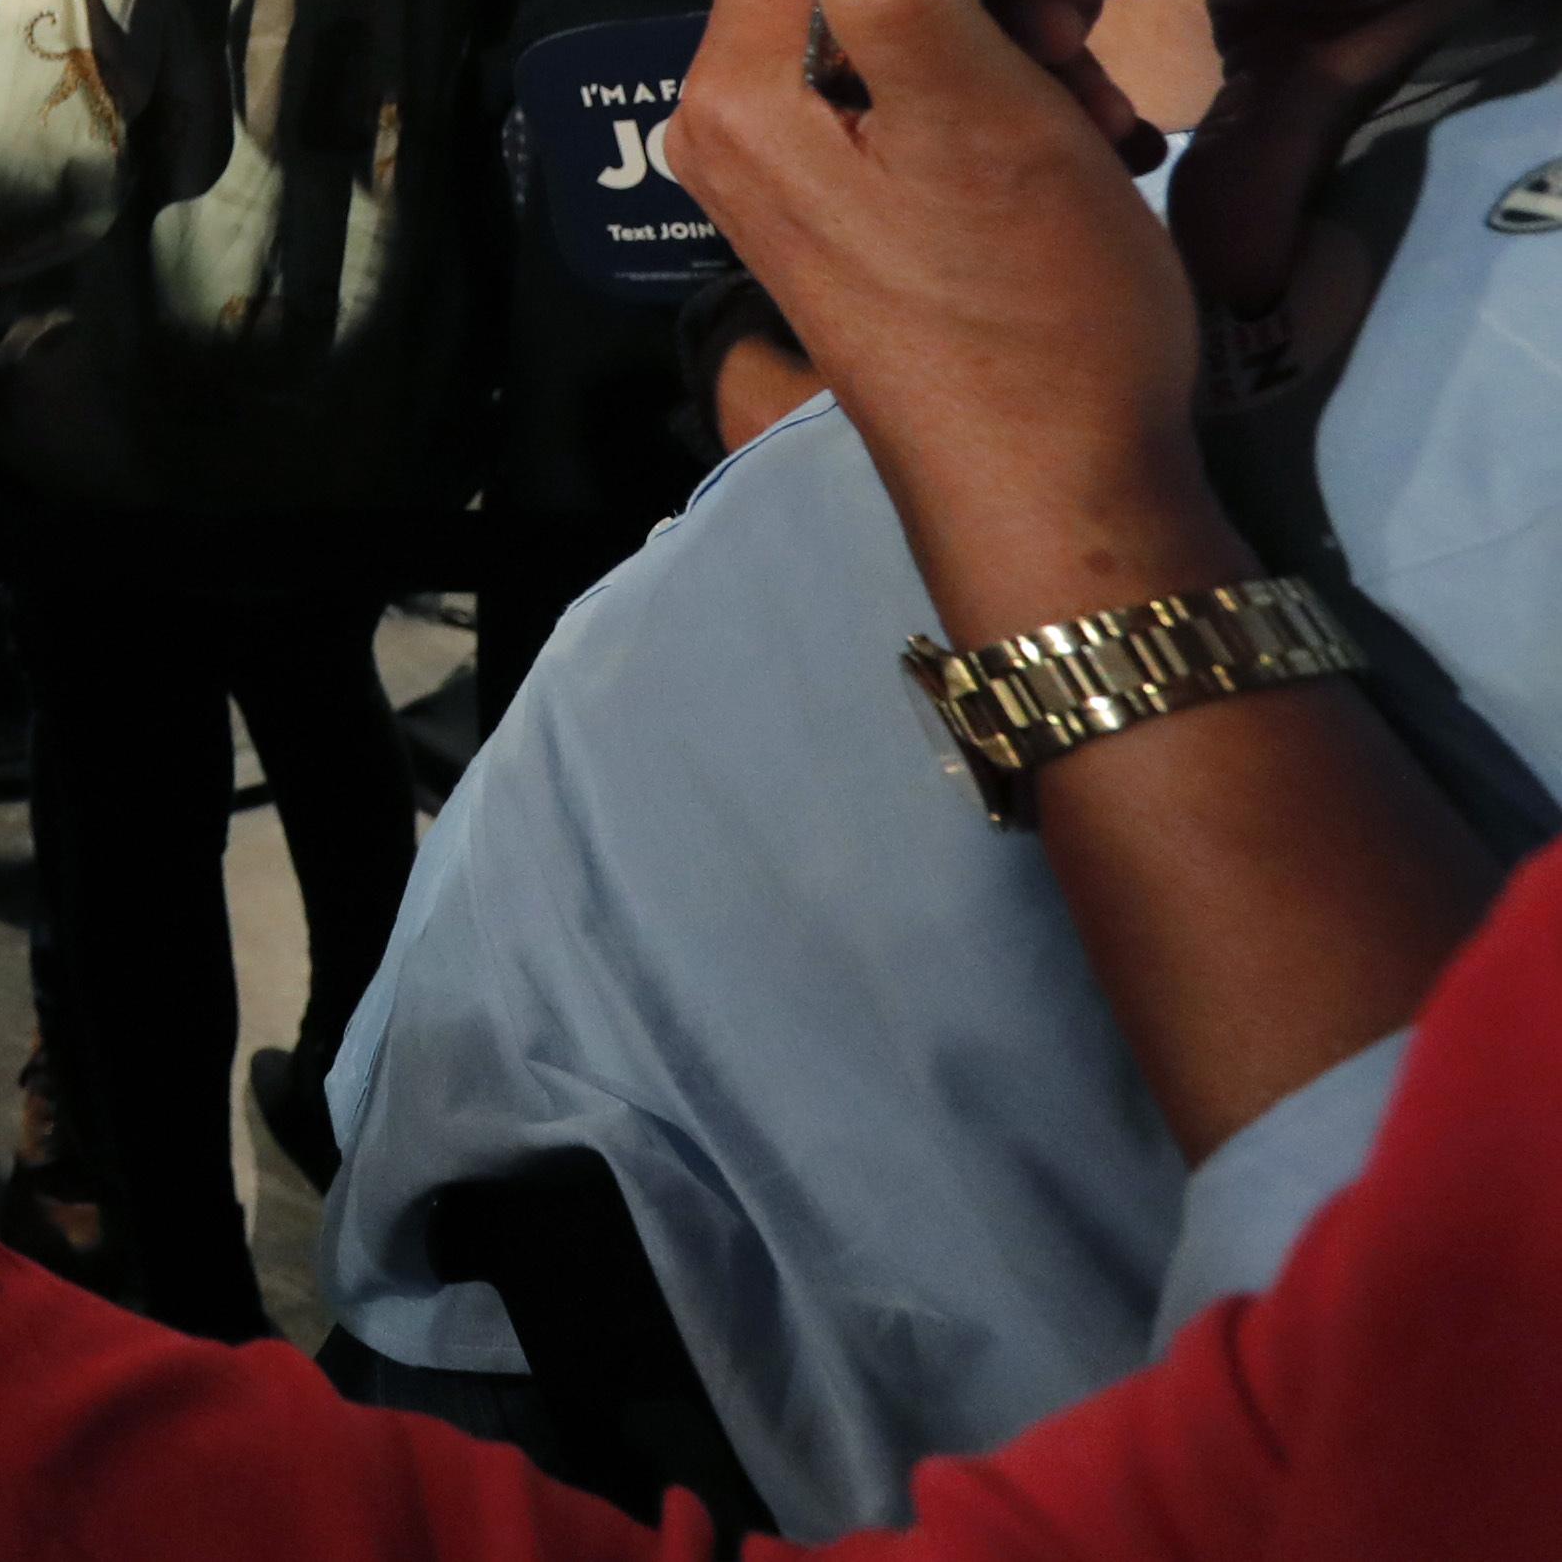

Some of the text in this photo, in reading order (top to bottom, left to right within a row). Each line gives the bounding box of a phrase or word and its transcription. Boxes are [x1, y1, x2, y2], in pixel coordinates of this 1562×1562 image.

[580, 83, 627, 108] I'M
[633, 81, 656, 105] A
[607, 221, 717, 242] Text JOIN
